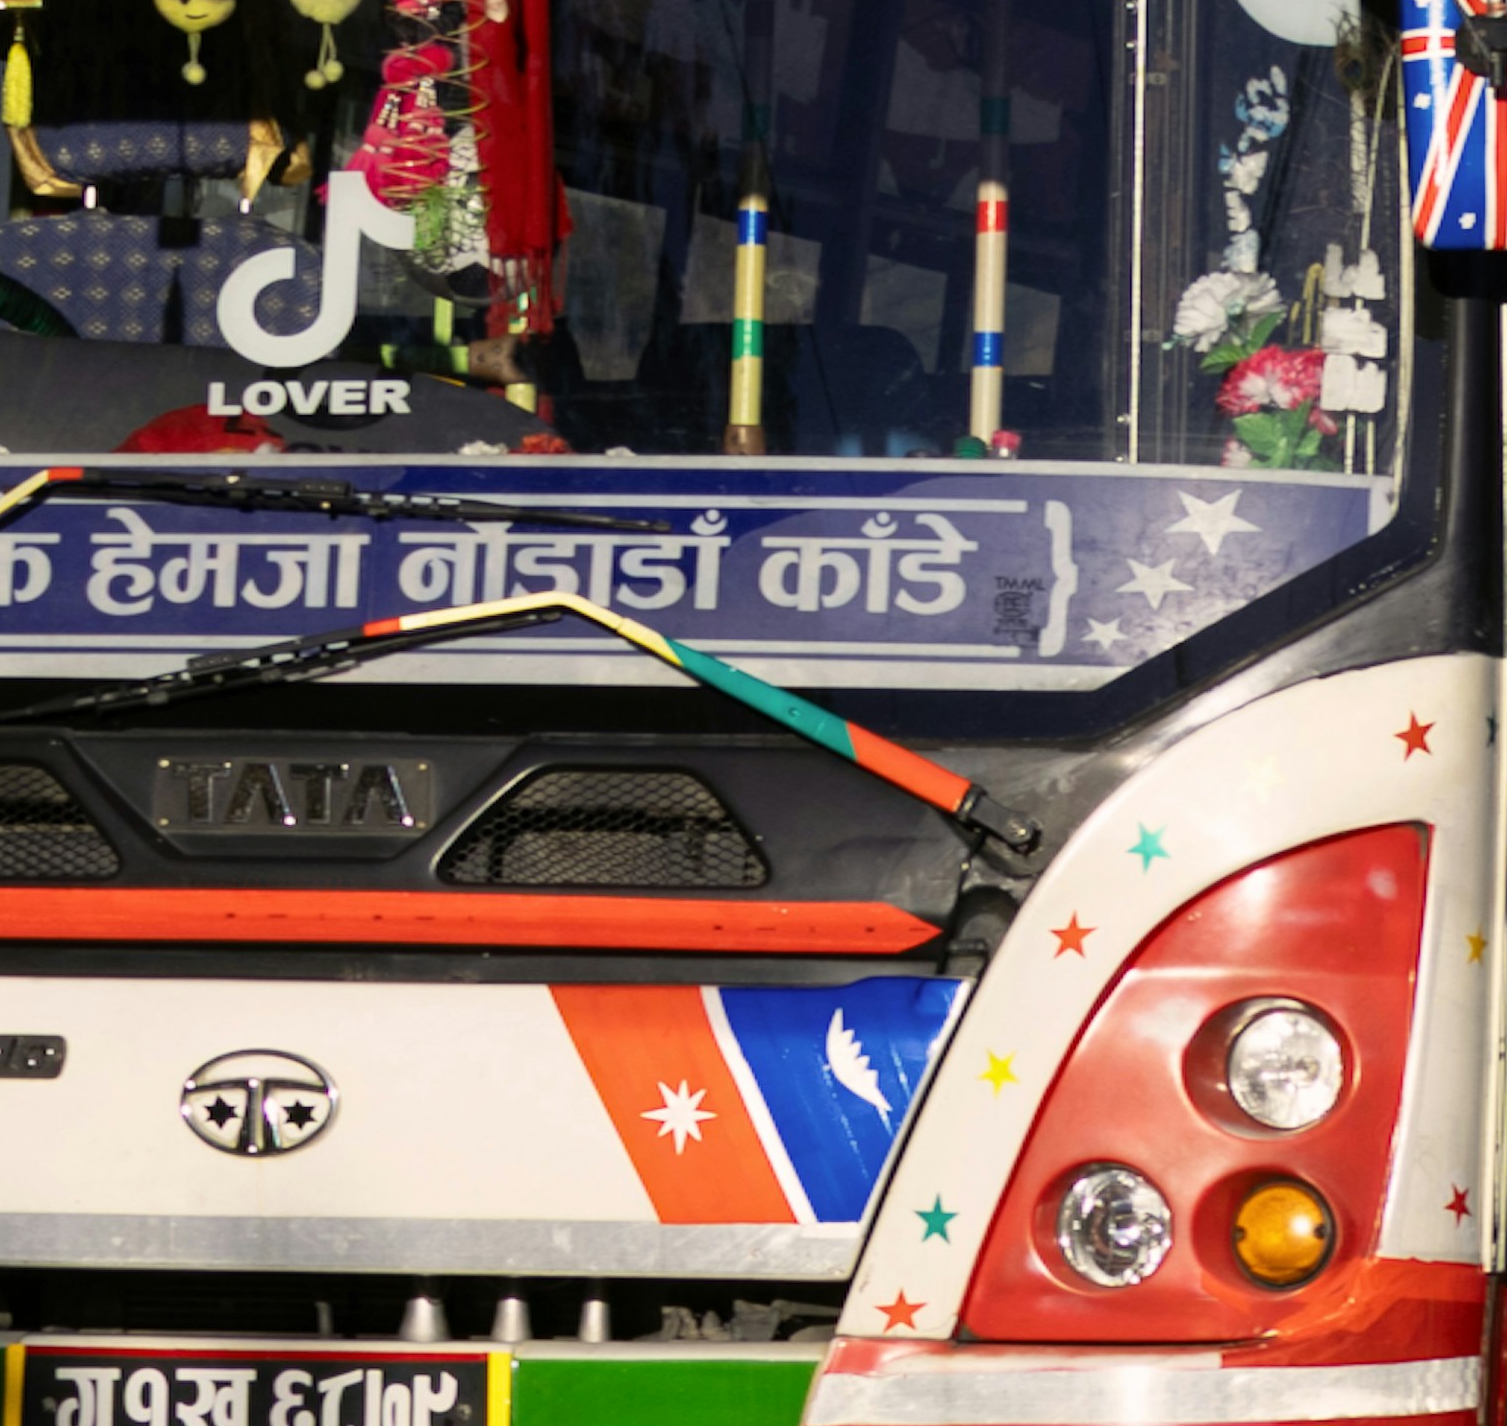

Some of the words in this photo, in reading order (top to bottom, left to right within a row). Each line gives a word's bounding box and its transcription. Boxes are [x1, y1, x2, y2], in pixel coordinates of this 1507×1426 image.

[206, 378, 413, 417] LOVER
[89, 506, 373, 616] हेमजा
[168, 762, 415, 825] TATA
